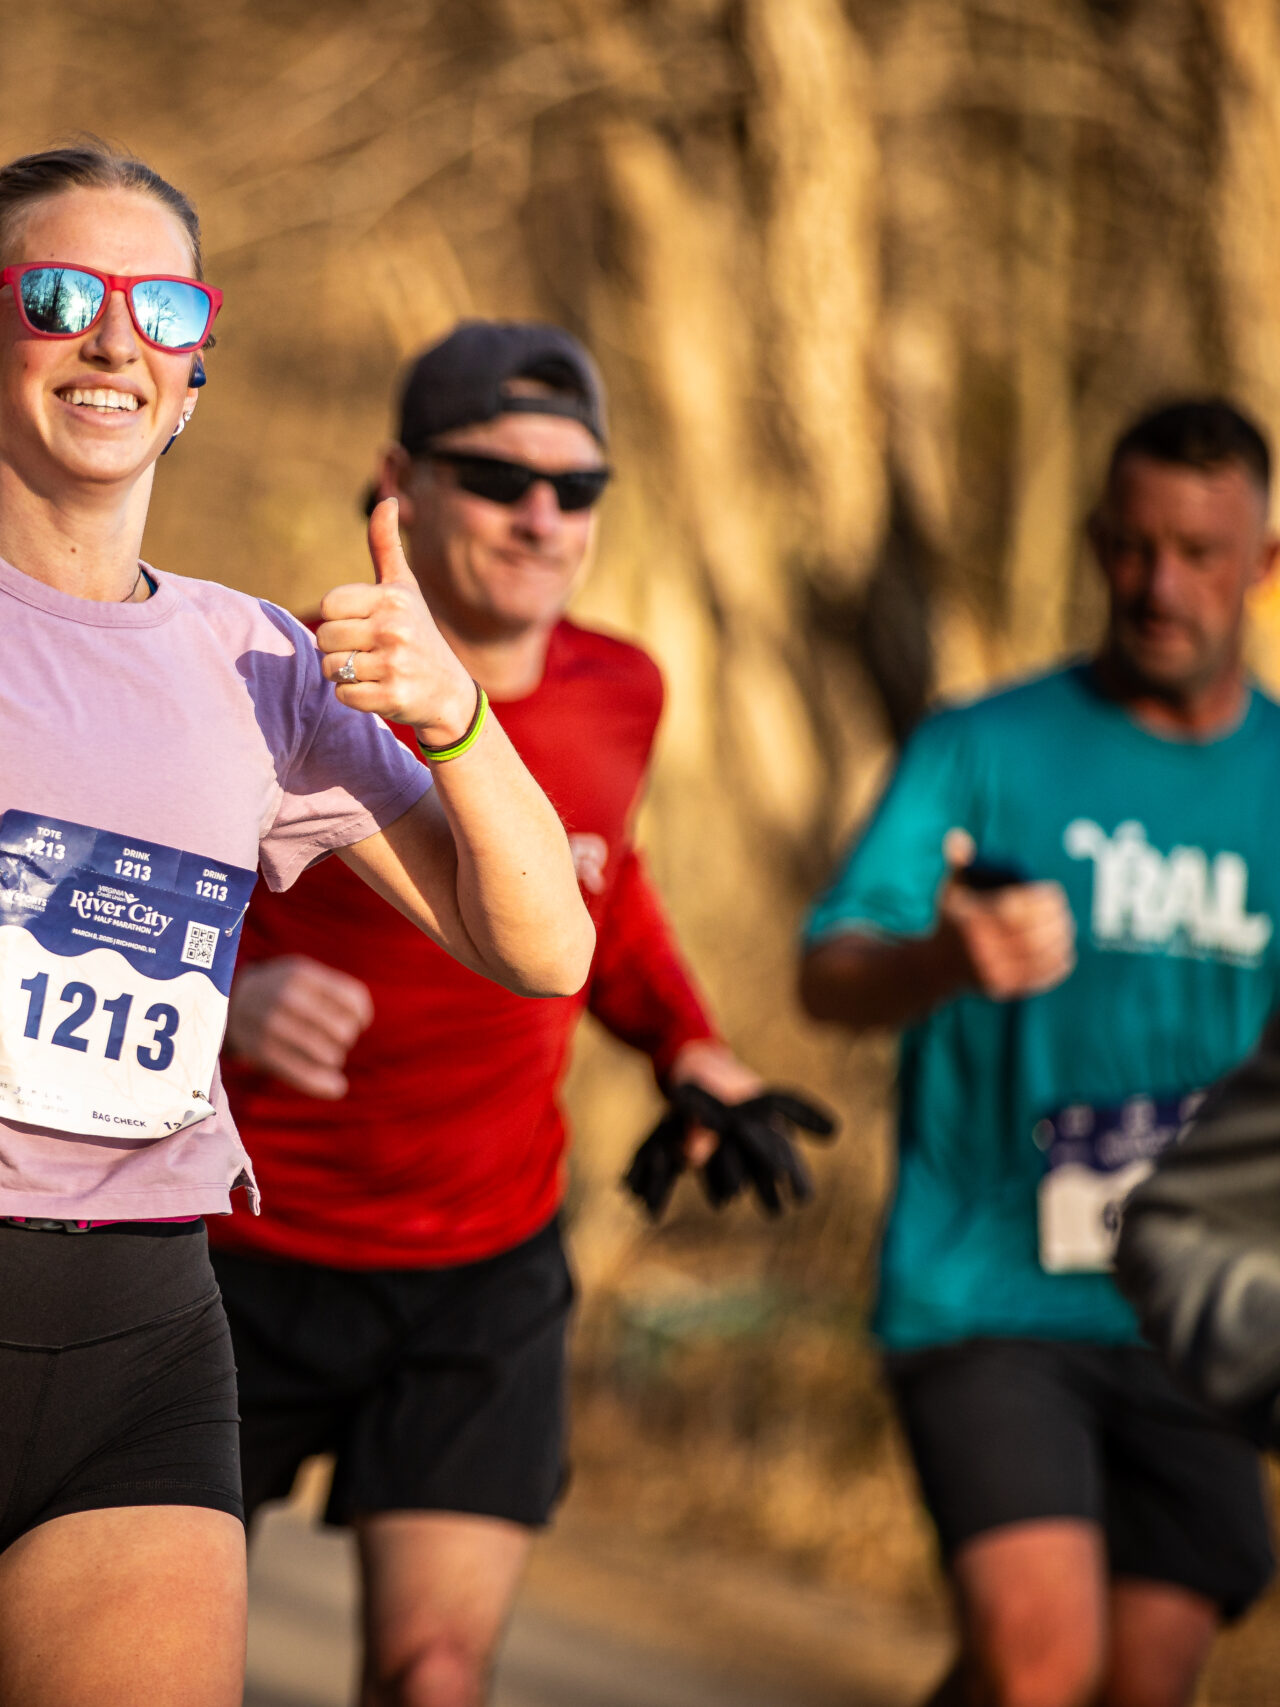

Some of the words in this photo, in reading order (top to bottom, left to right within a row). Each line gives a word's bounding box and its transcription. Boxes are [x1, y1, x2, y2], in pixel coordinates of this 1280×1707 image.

[36, 826, 63, 840] TOTE
[25, 837, 66, 860] 1213
[123, 847, 151, 861] DRINK
[114, 858, 152, 881] 1213
[202, 868, 229, 882] DRINK
[195, 879, 229, 902] 1213
[69, 889, 126, 919] River
[128, 903, 174, 937] City
[93, 914, 113, 925] HALF
[112, 918, 152, 935] MARATHON
[71, 927, 93, 938] MARCH
[147, 946, 157, 954] VA
[20, 971, 180, 1072] 1213
[92, 1110, 111, 1122] BAG
[113, 1116, 147, 1128] CHECK
